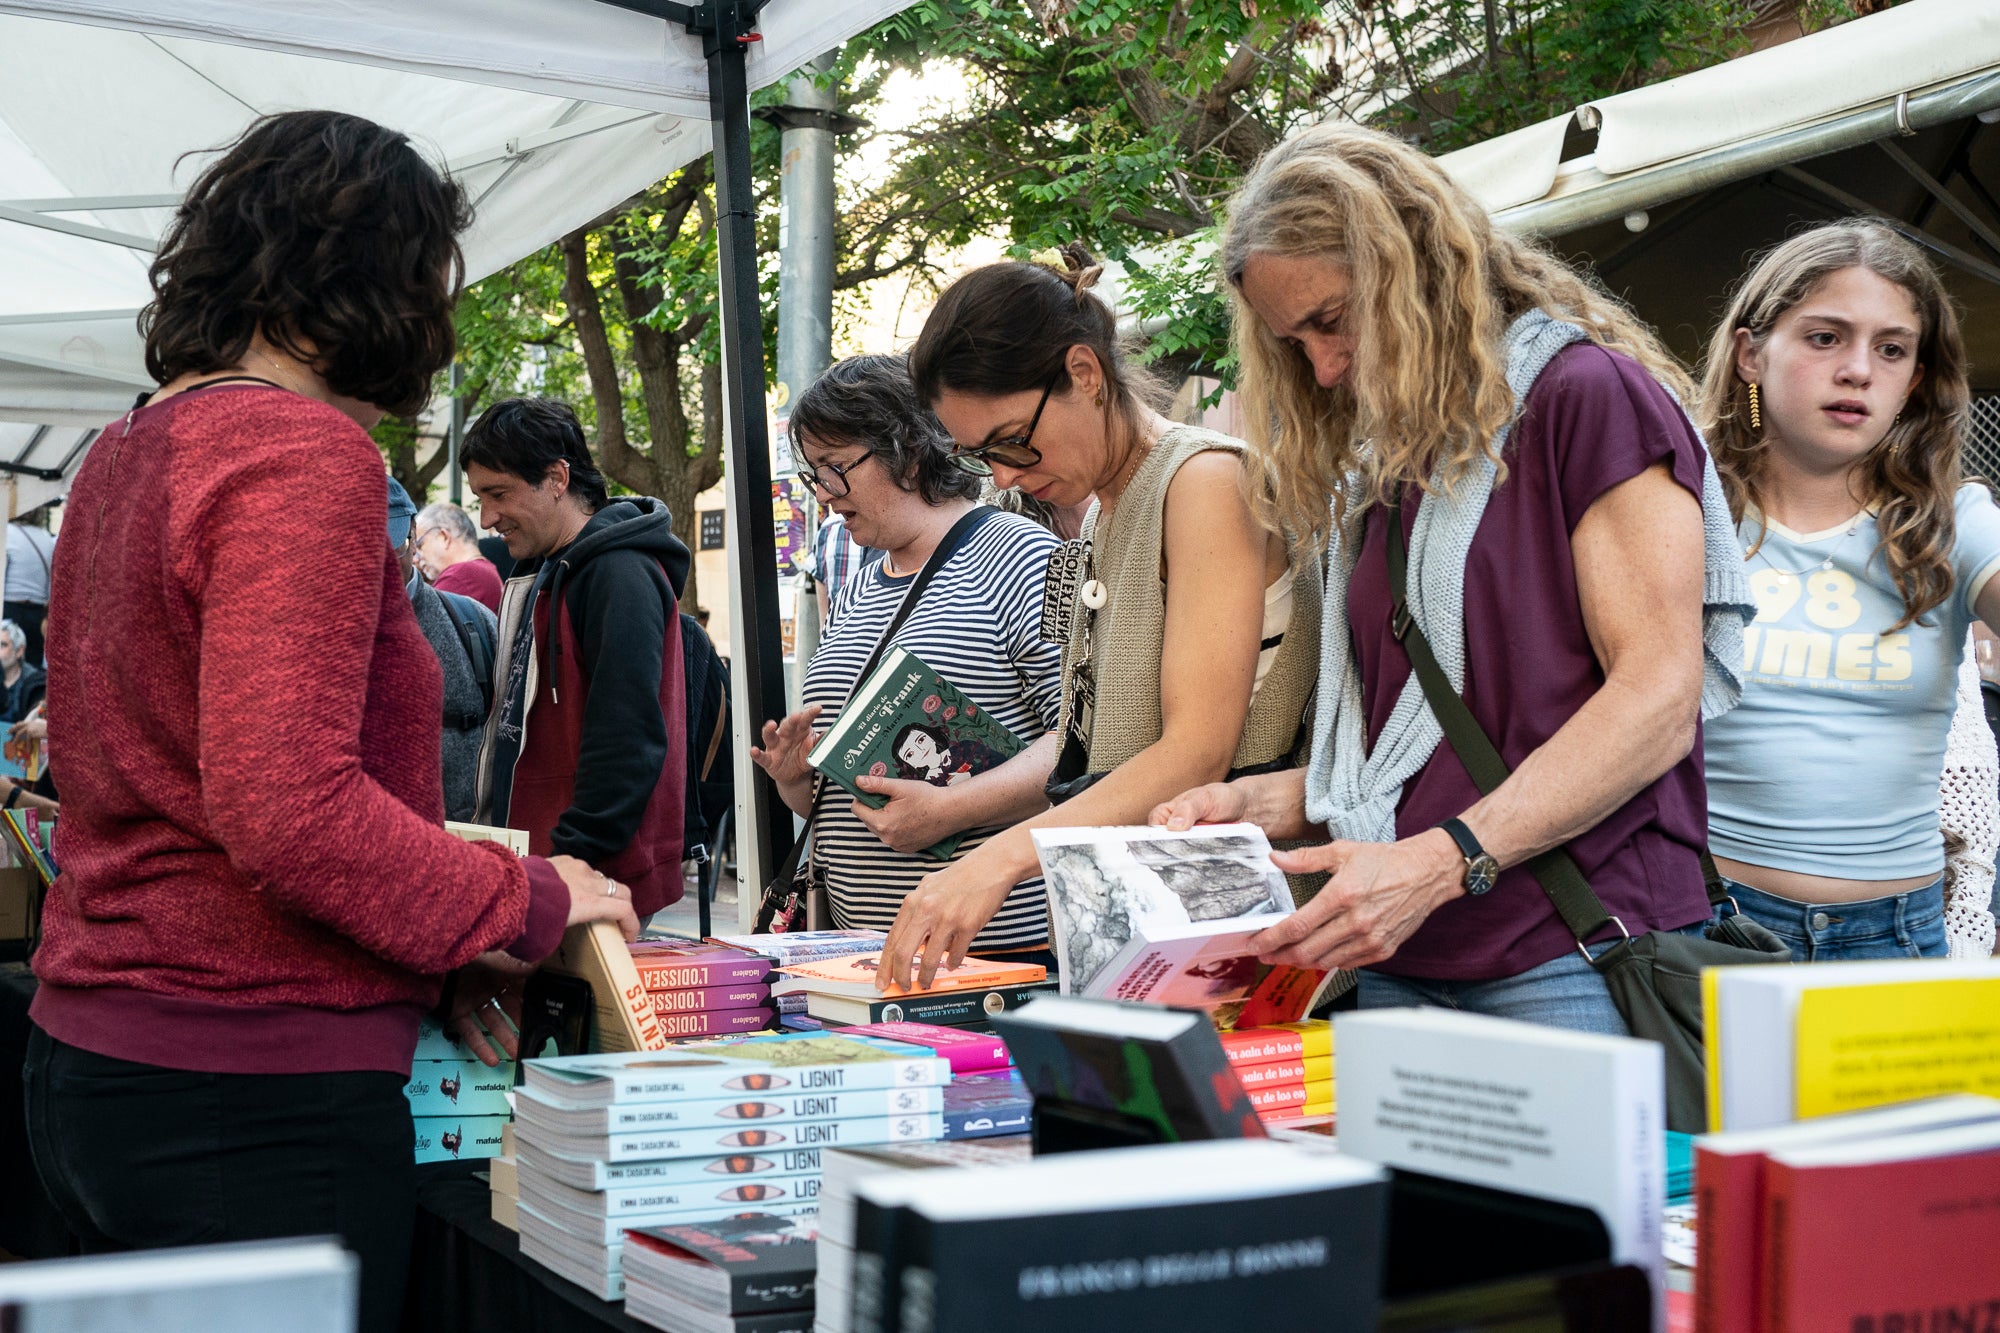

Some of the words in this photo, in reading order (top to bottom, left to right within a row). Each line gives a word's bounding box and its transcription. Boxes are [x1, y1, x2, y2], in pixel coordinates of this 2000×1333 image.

[1750, 569, 1861, 629] 98
[903, 686, 924, 710] Hesse
[844, 722, 881, 770] Anne
[878, 671, 922, 718] Frank
[856, 722, 867, 732] El
[866, 703, 881, 722] diario
[880, 694, 889, 703] de
[643, 967, 709, 989] L'ODISSEA
[732, 969, 760, 977] laGalera
[649, 991, 705, 1012] L'ODISSE
[729, 992, 758, 1001] laGalera
[659, 1014, 708, 1035] L'ODISS
[732, 1016, 760, 1024] laGalera
[1240, 1046, 1261, 1059] sala
[1263, 1044, 1275, 1055] de
[1277, 1042, 1292, 1053] los
[800, 1069, 844, 1088] LIGNIT
[1242, 1071, 1264, 1083] sala
[1265, 1069, 1277, 1079] de
[1279, 1067, 1293, 1078] los
[474, 1083, 506, 1092] mafalda
[1263, 1092, 1275, 1103] de
[1276, 1091, 1291, 1101] los
[793, 1096, 837, 1116] LIGNIT
[475, 1135, 502, 1145] mafald
[795, 1124, 839, 1144] LIGNIT
[784, 1150, 821, 1170] LIGNI
[794, 1179, 821, 1198] LIG
